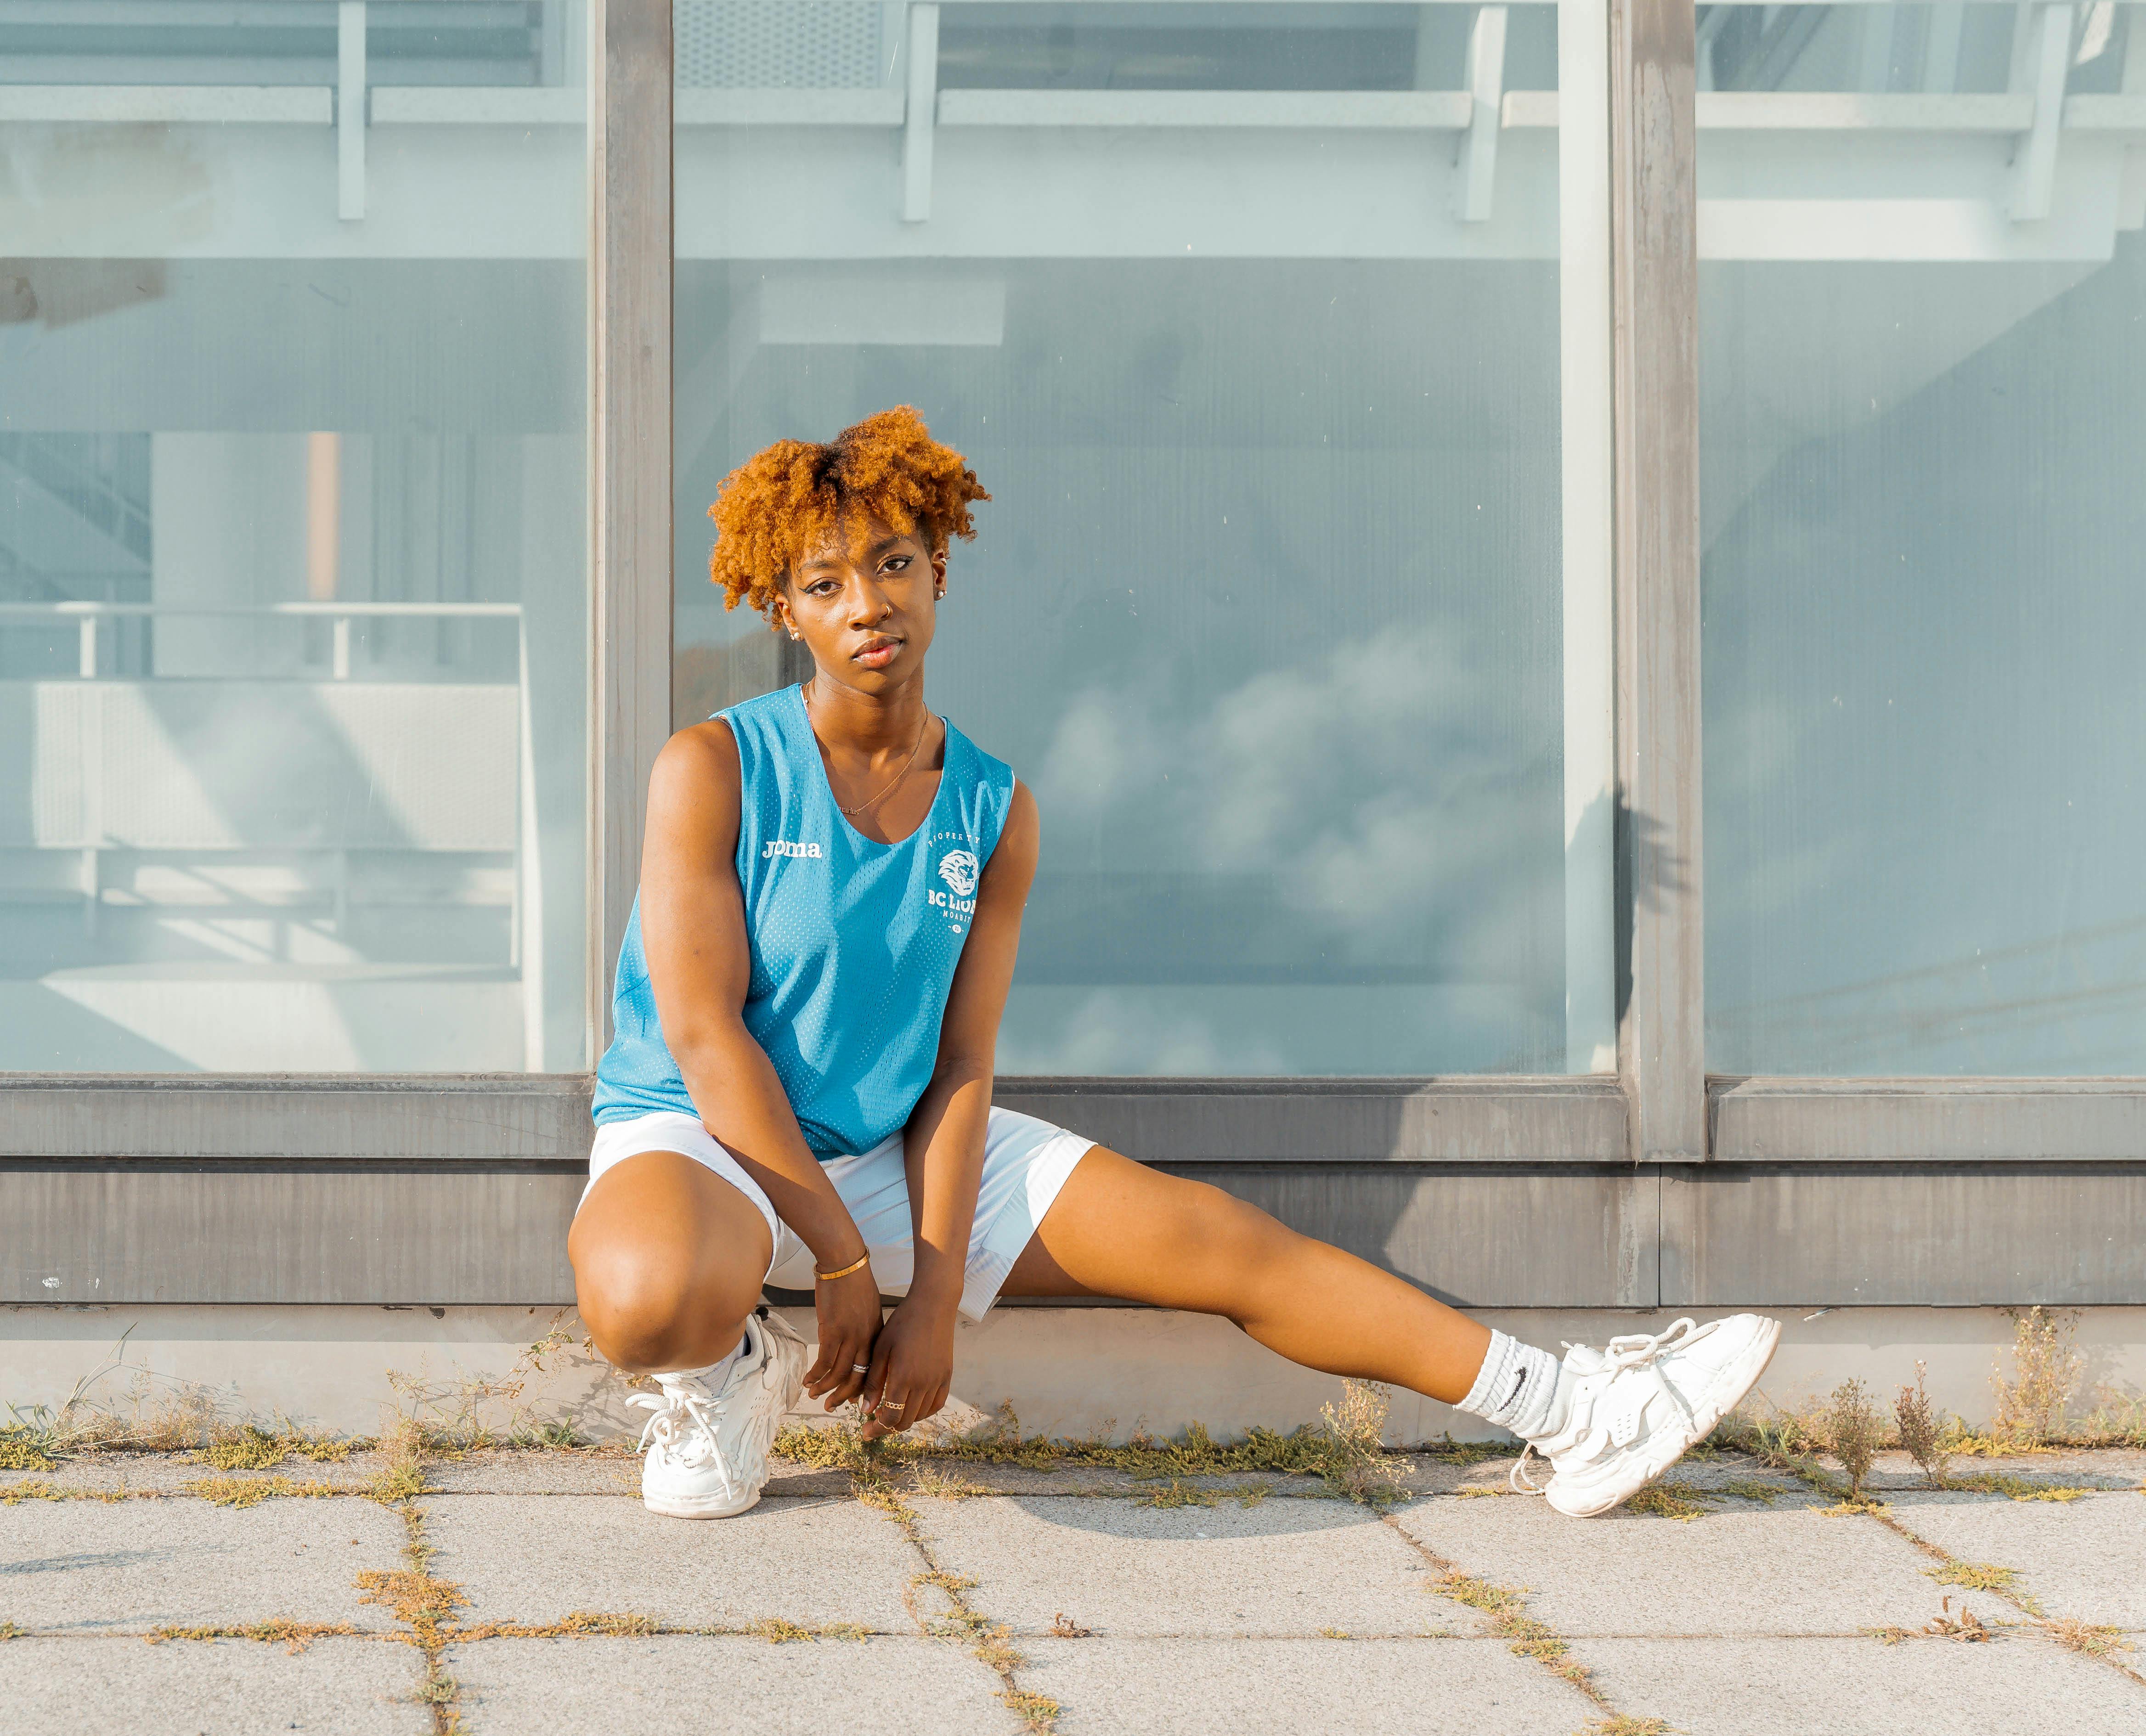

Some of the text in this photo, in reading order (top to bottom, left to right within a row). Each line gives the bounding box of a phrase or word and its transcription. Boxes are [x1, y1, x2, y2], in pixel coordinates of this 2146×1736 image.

[928, 832, 980, 847] PROPERTY
[762, 840, 823, 858] Joma
[928, 889, 946, 907] BC
[943, 910, 971, 923] MOABIT
